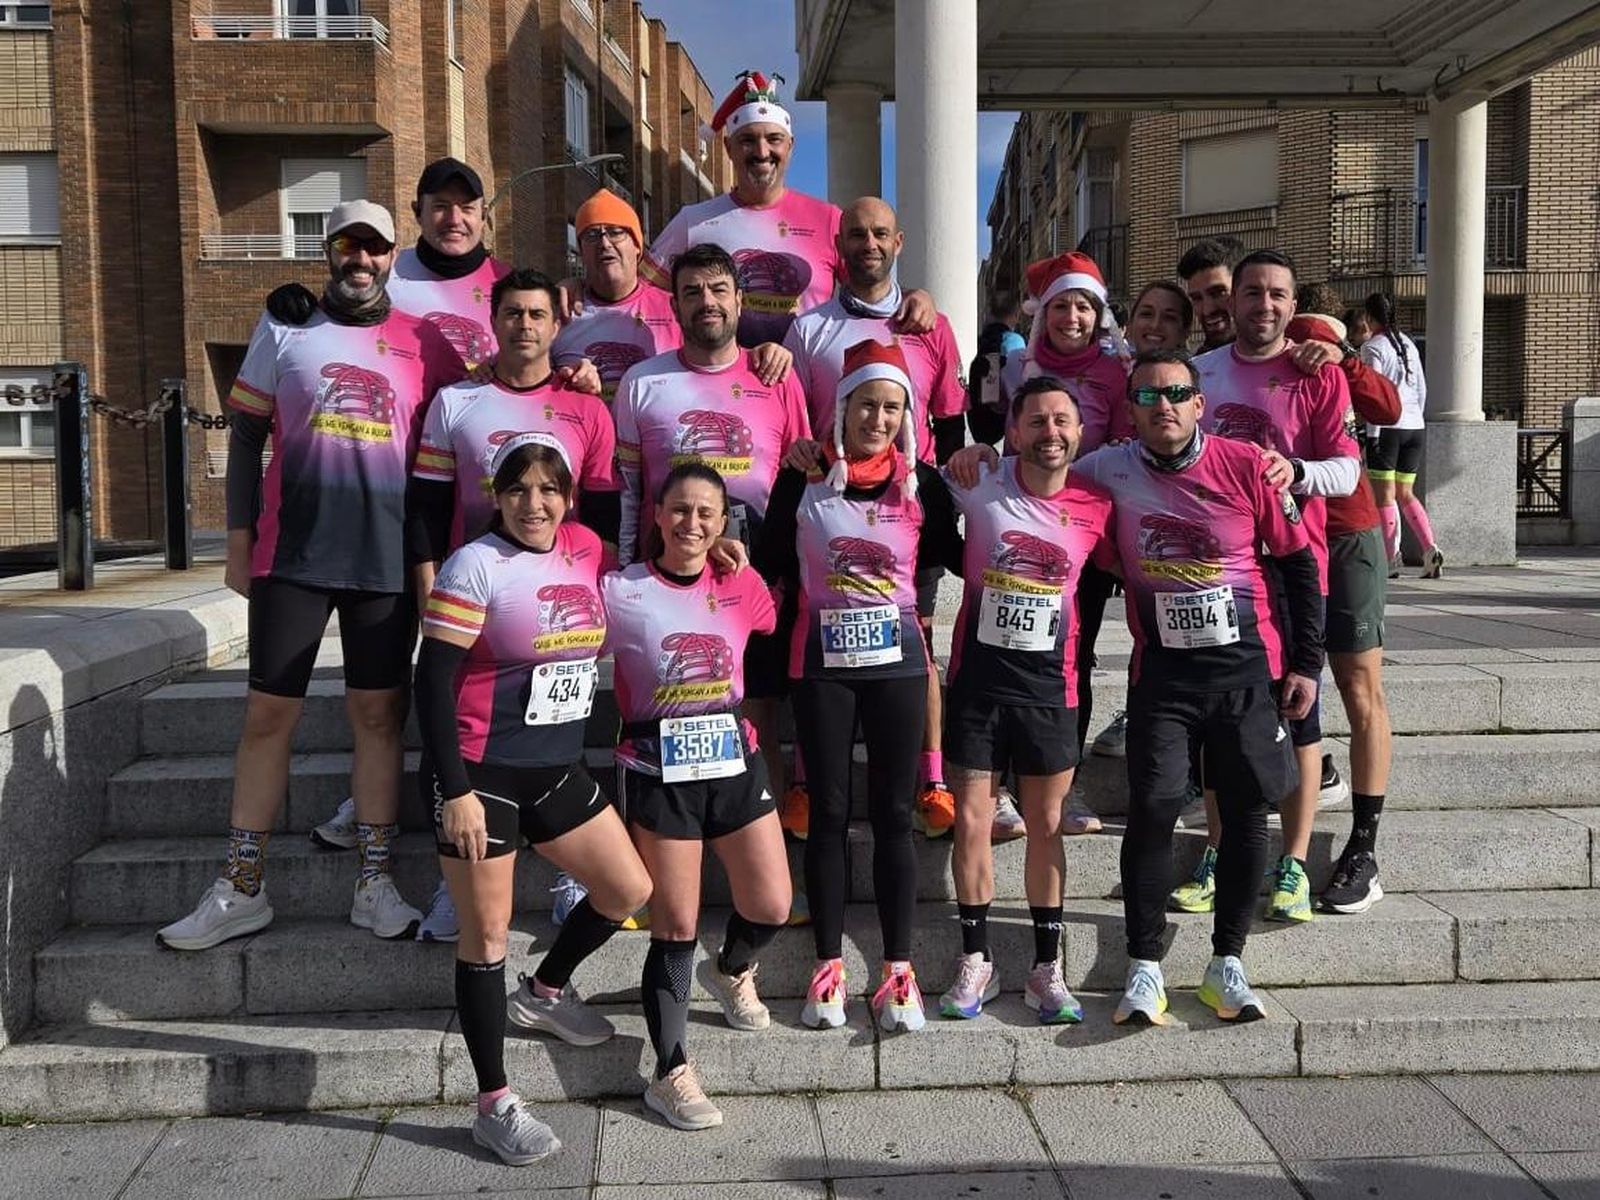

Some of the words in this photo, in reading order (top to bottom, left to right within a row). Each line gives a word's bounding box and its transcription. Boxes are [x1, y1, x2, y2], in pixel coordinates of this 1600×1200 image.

[1003, 594, 1054, 607] SETEL
[1174, 591, 1225, 606] SETEL
[841, 610, 892, 623] SETEL
[996, 606, 1036, 632] 845
[1166, 605, 1218, 630] 3894
[533, 639, 551, 650] QUE
[831, 623, 884, 649] 3893
[547, 677, 580, 703] 434
[684, 719, 732, 732] SETEL
[674, 731, 725, 761] 3587
